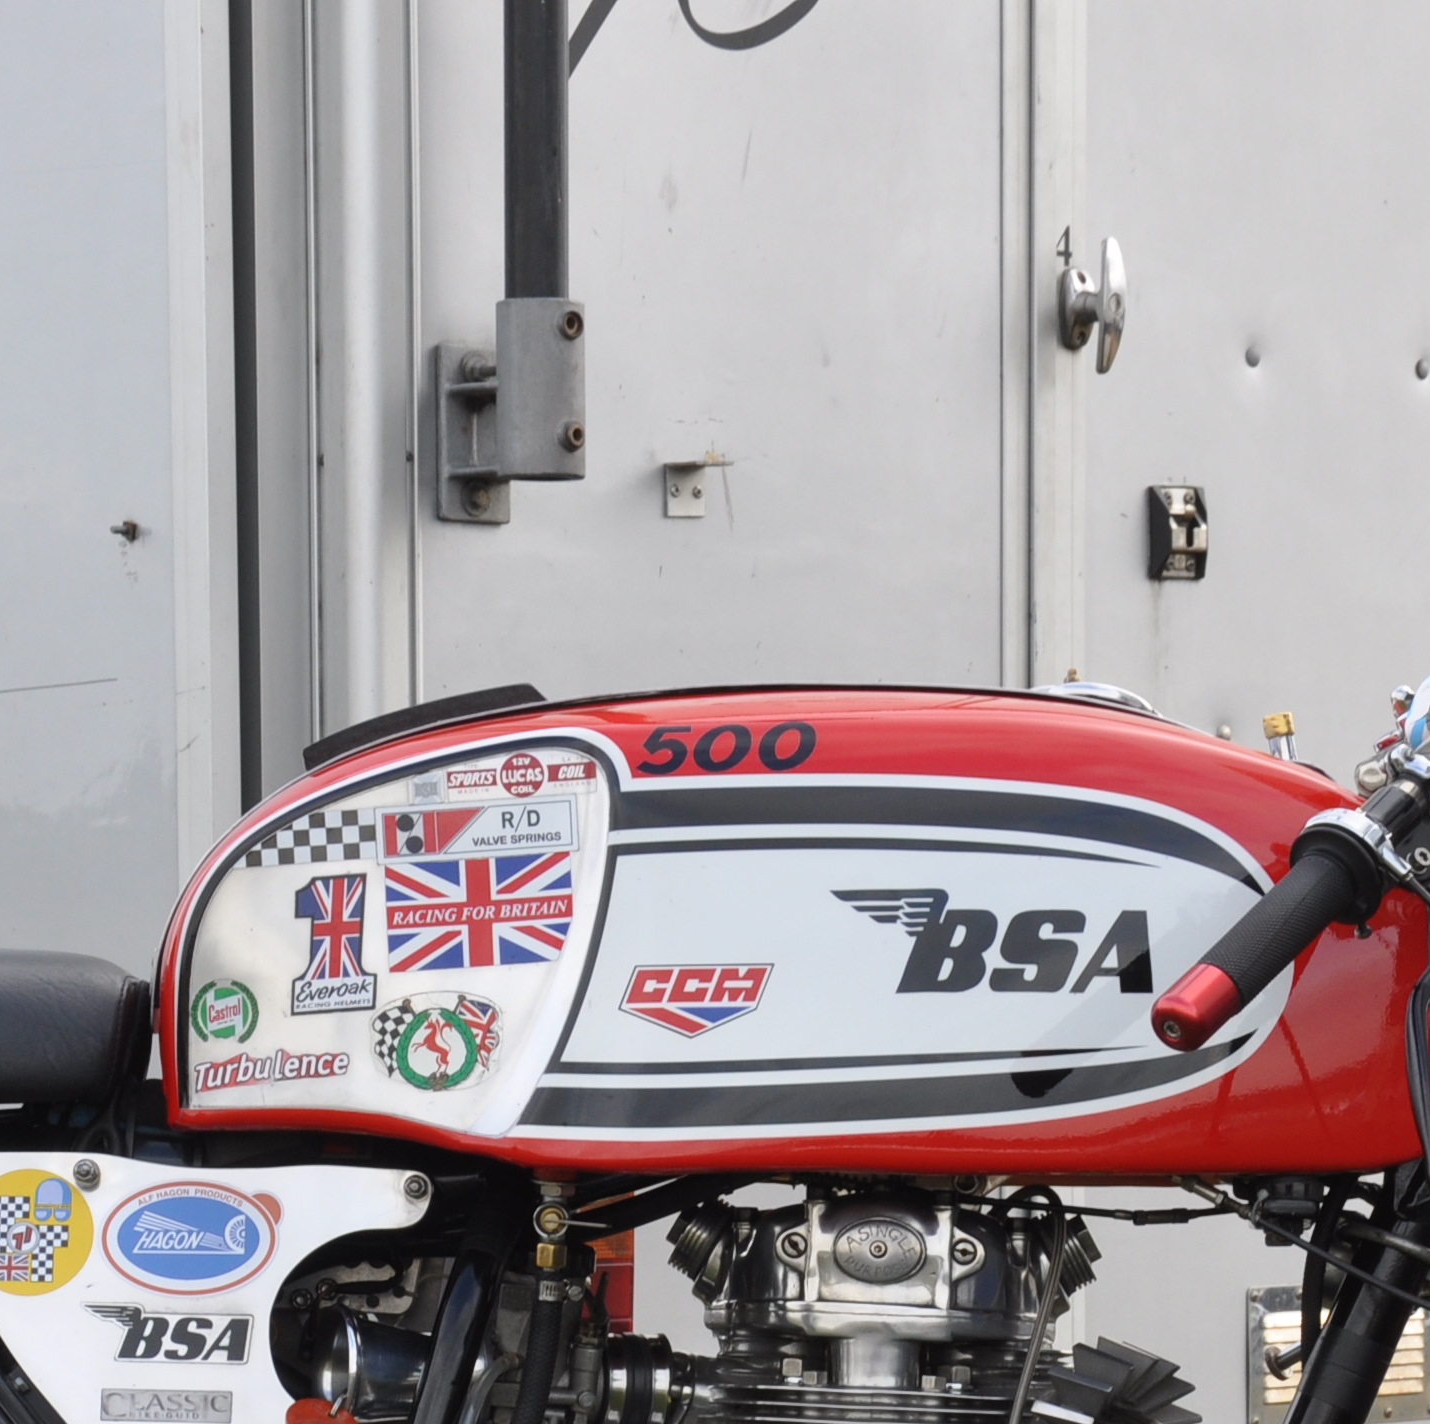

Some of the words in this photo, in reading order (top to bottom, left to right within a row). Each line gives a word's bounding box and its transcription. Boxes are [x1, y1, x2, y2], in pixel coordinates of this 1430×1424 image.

[635, 720, 817, 776] 500
[512, 756, 532, 767] 12V
[448, 769, 496, 788] SPORTS
[501, 767, 544, 784] LUCAS
[557, 764, 586, 780] COIL
[510, 784, 536, 795] COIL
[500, 805, 541, 833] R/D
[472, 835, 507, 847] VALVE
[510, 831, 562, 845] SPRINGS
[392, 906, 459, 926] RACING
[461, 903, 496, 920] FOR
[499, 899, 569, 919] BRITAIN
[896, 907, 1155, 995] BSA
[296, 978, 373, 1003] Everoak
[208, 997, 241, 1025] Castrol
[295, 1001, 331, 1010] RACING
[333, 998, 371, 1007] HELMETS
[194, 1049, 350, 1094] Turbulence
[137, 1193, 155, 1207] ALF
[156, 1187, 190, 1199] HAGON
[194, 1187, 244, 1208] PRODUCTS
[138, 1230, 205, 1251] HAGON
[117, 1316, 250, 1362] BSA
[102, 1392, 229, 1419] CLASSIC
